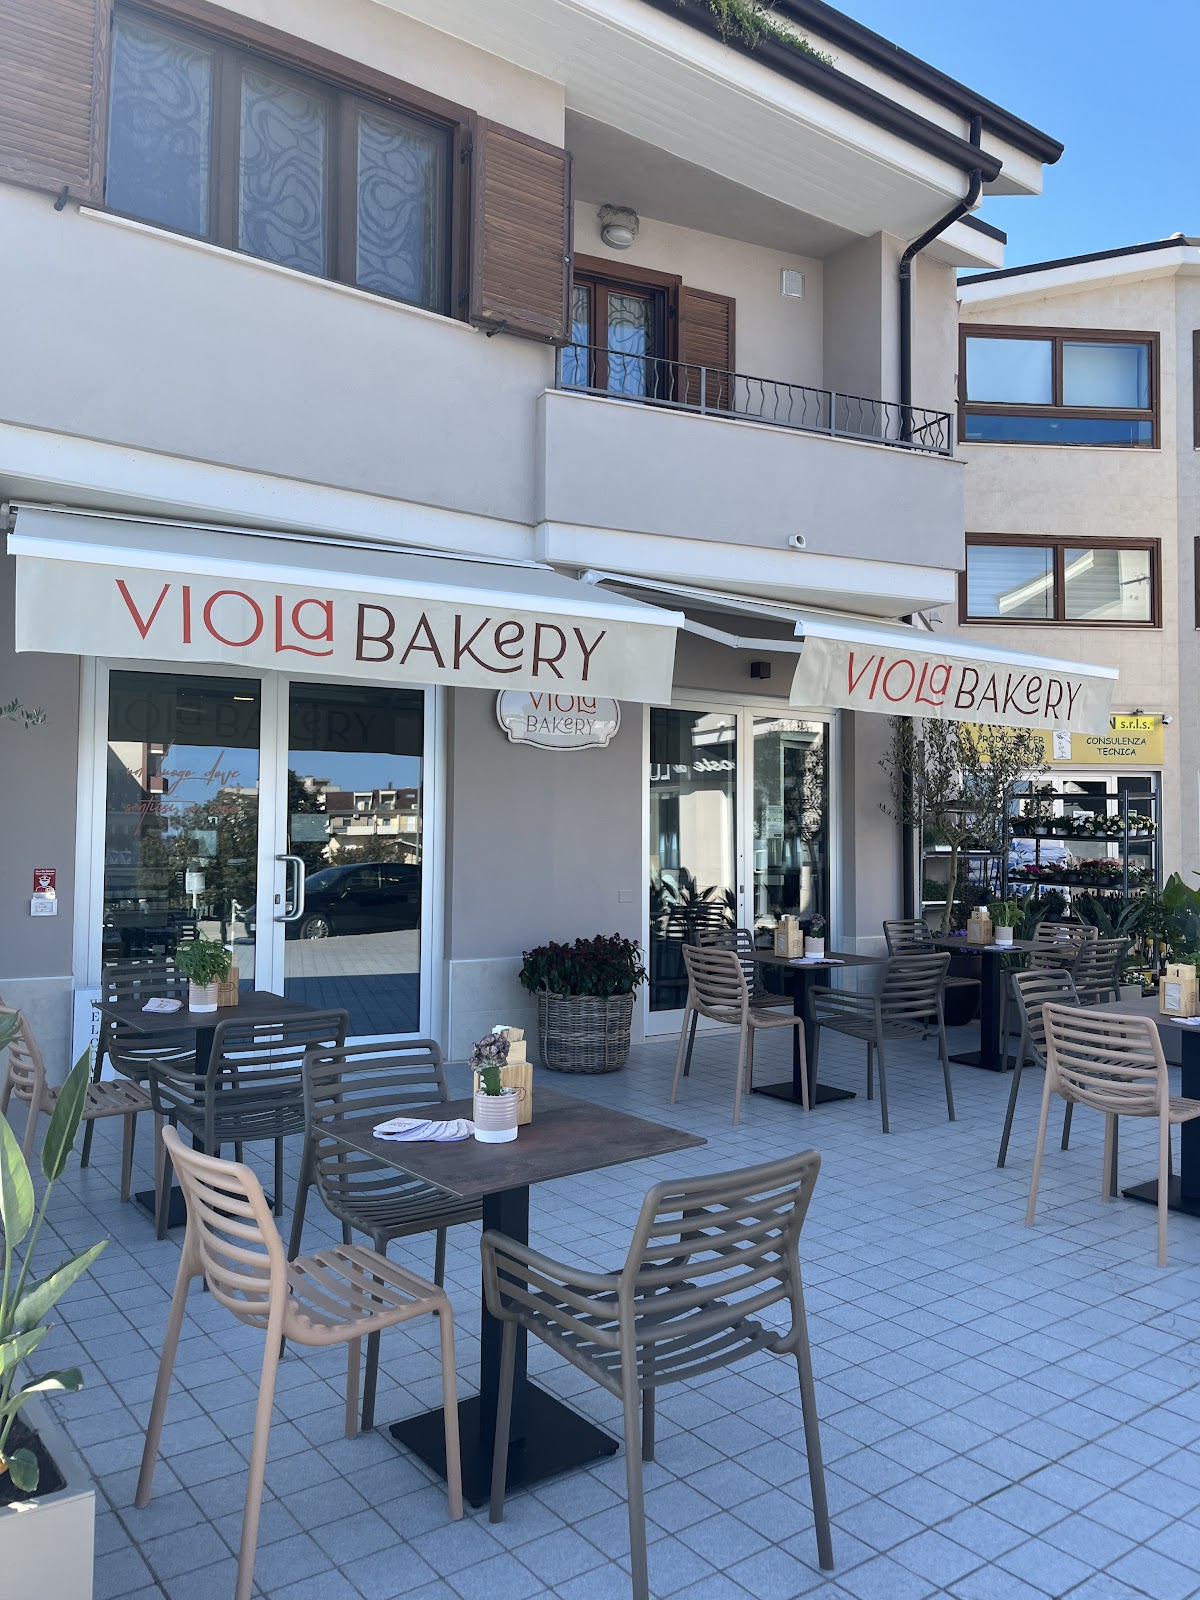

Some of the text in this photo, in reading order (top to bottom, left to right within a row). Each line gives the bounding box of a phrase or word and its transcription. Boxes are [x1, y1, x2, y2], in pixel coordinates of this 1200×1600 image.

[1120, 718, 1150, 730] s.r.l.s.
[1086, 737, 1146, 746] CONSULENZA
[1097, 747, 1137, 756] TECNICA
[204, 750, 241, 786] dove
